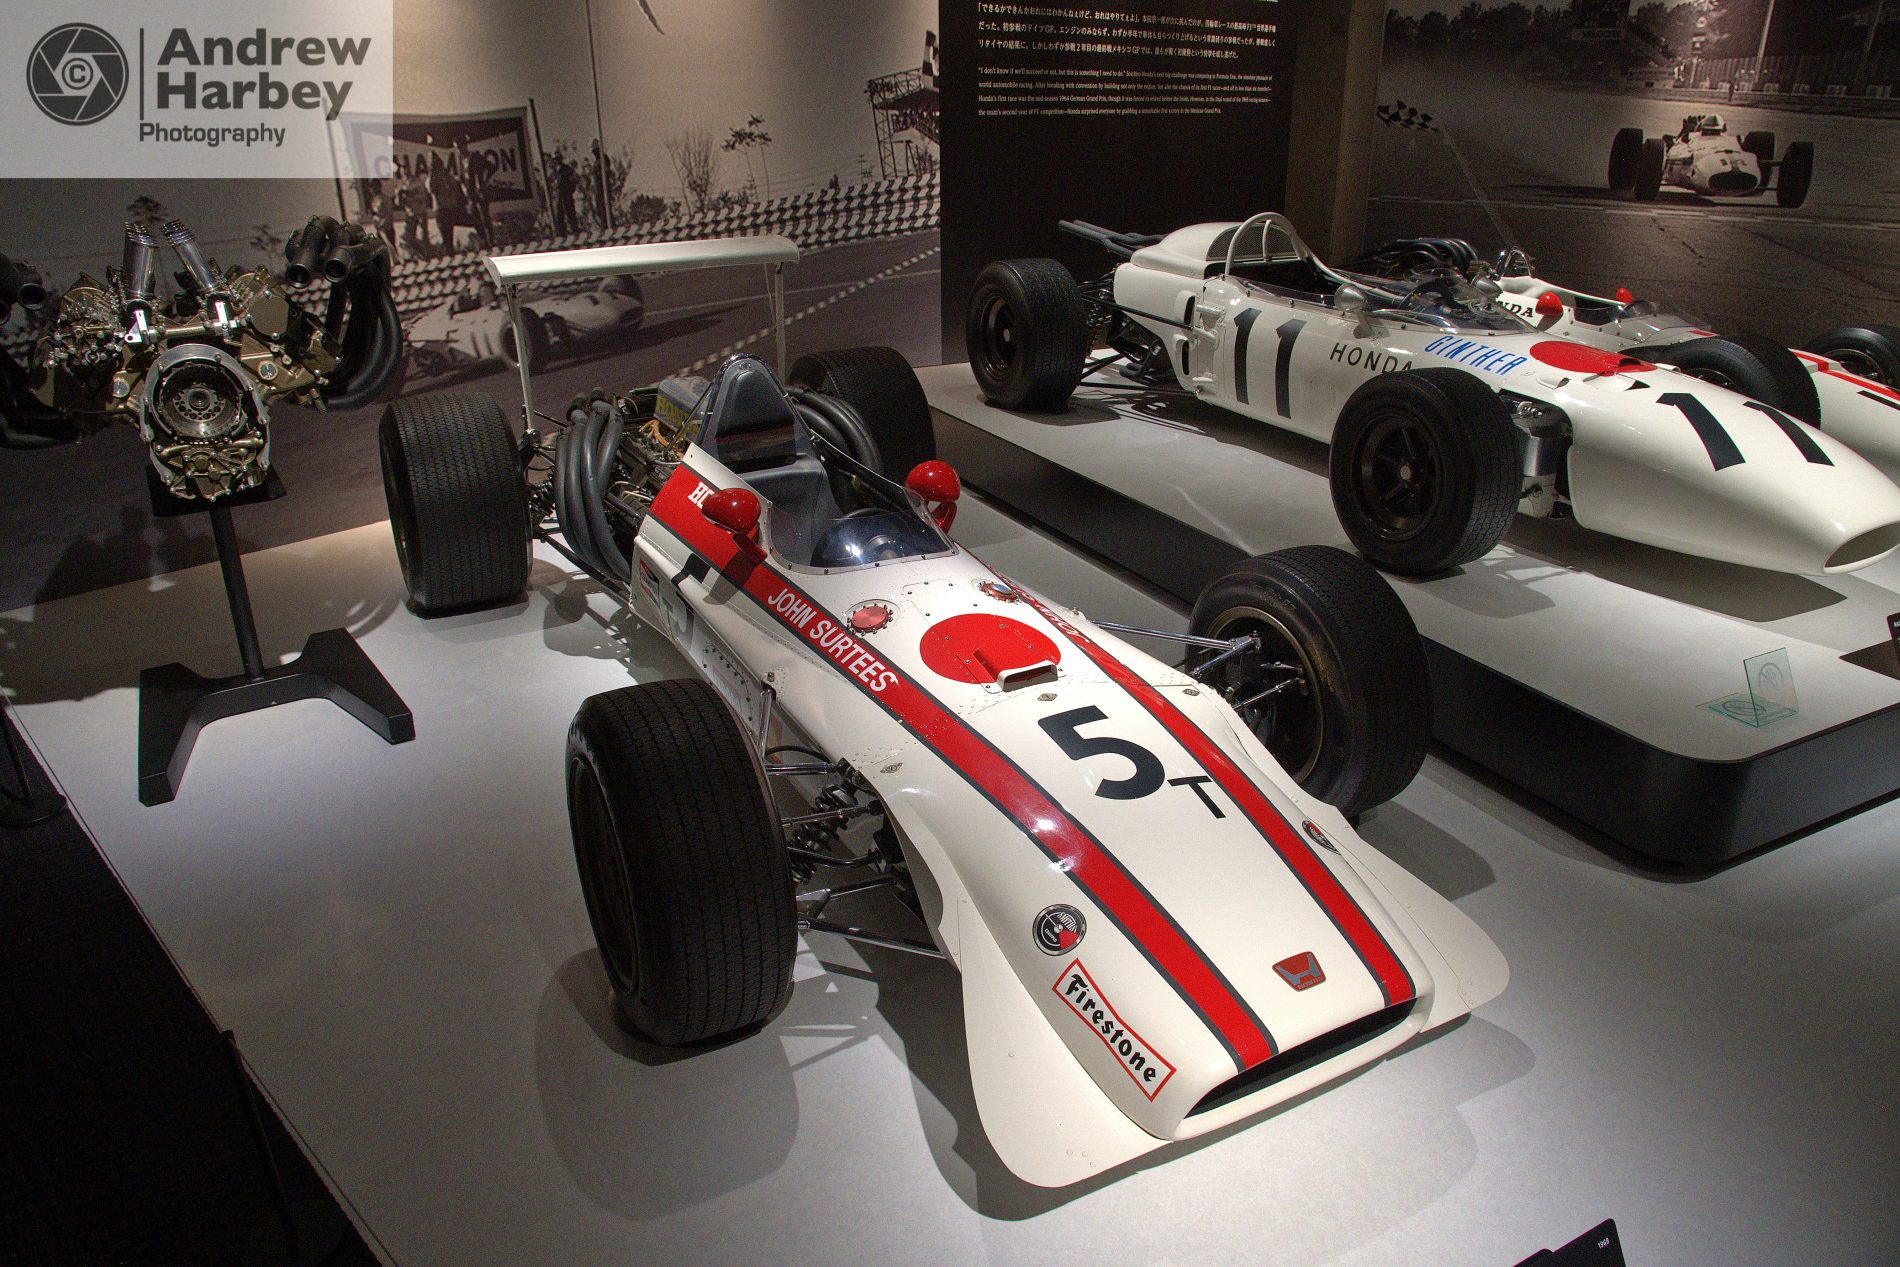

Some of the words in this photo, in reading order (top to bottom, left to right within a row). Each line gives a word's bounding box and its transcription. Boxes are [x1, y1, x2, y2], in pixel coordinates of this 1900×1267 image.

[1234, 307, 1307, 419] 11
[1424, 335, 1528, 375] GINTHER
[1656, 393, 1835, 472] 11
[767, 588, 817, 629] JOHN
[809, 620, 899, 692] SURTEES
[1065, 973, 1156, 1082] Firestone
